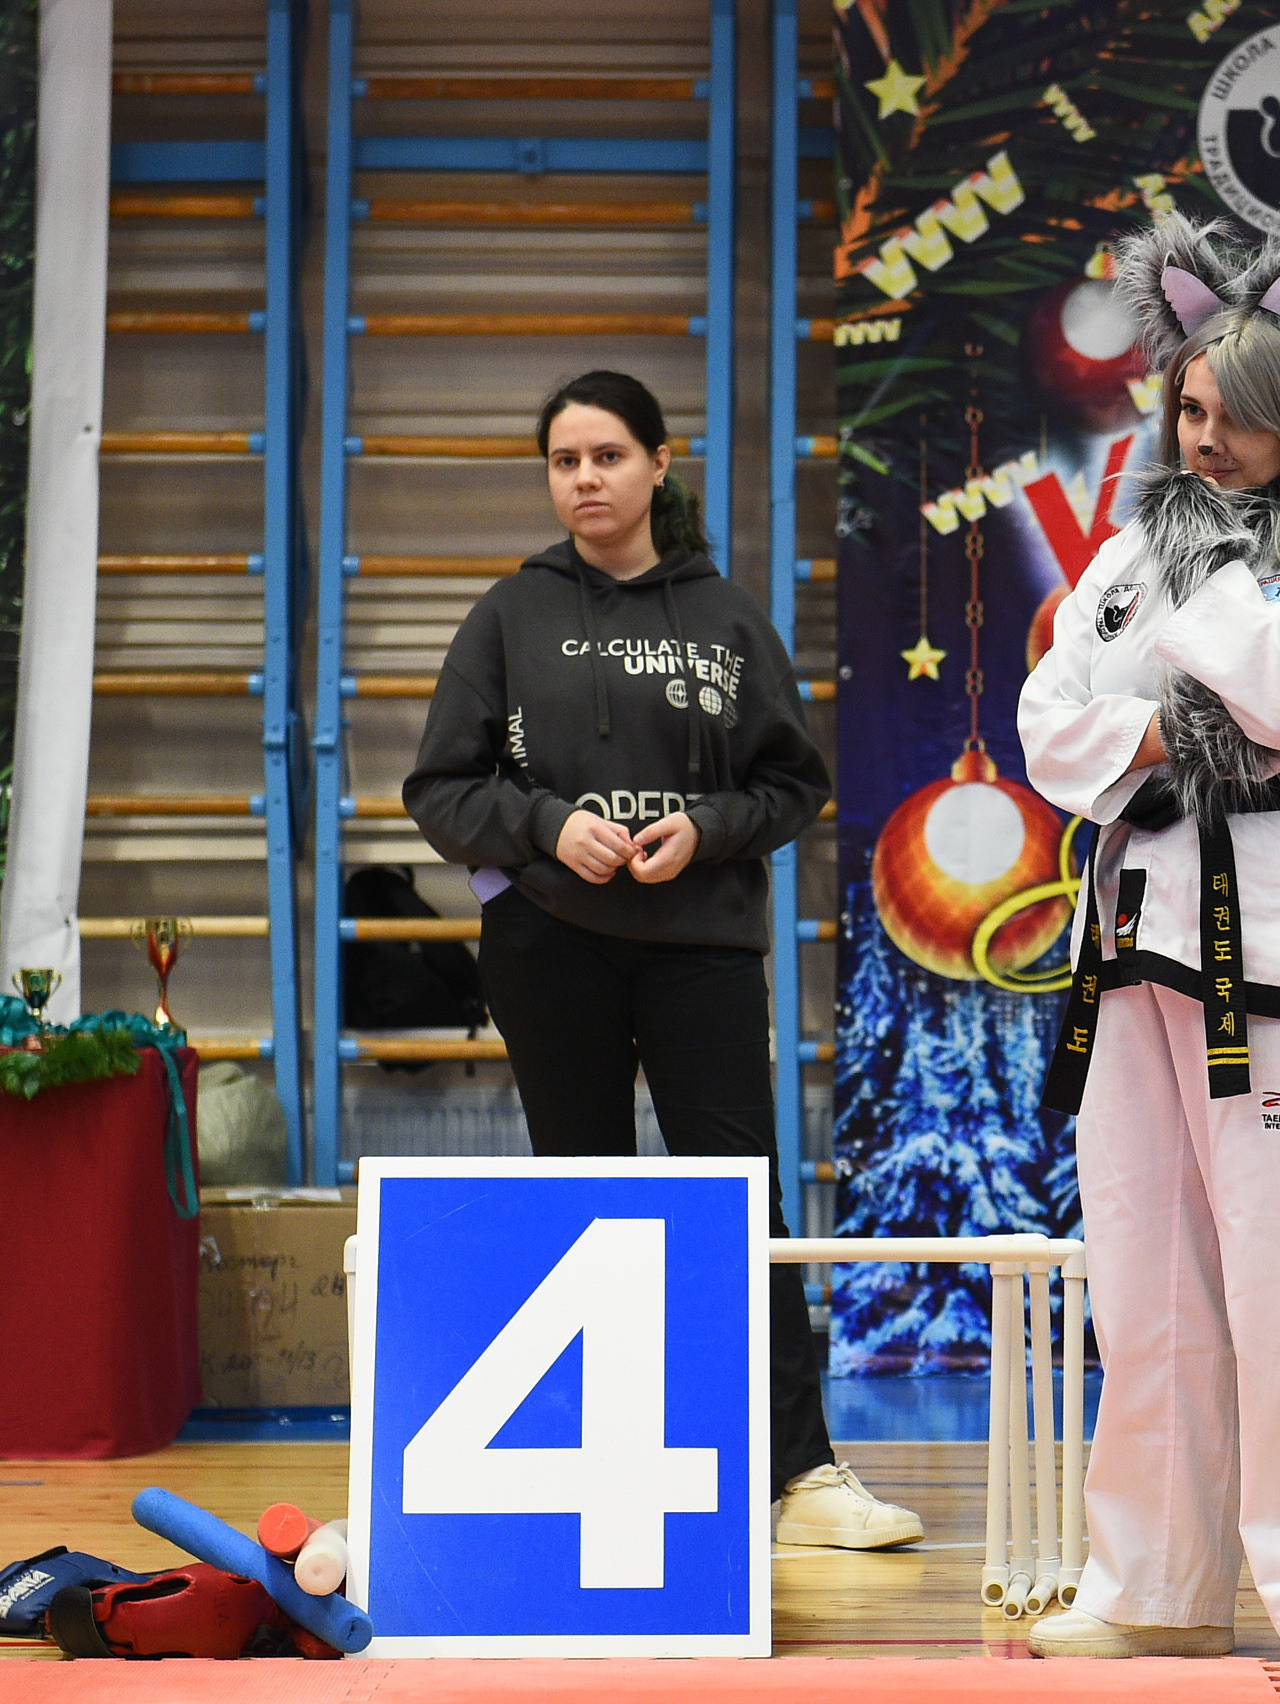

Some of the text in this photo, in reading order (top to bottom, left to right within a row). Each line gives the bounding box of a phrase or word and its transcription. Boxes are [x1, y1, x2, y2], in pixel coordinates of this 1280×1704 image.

[1211, 37, 1277, 100] ШКОЛА
[561, 638, 745, 678] CALCULATE THE
[624, 654, 742, 701] UNIVERSE
[402, 1217, 718, 1589] 4
